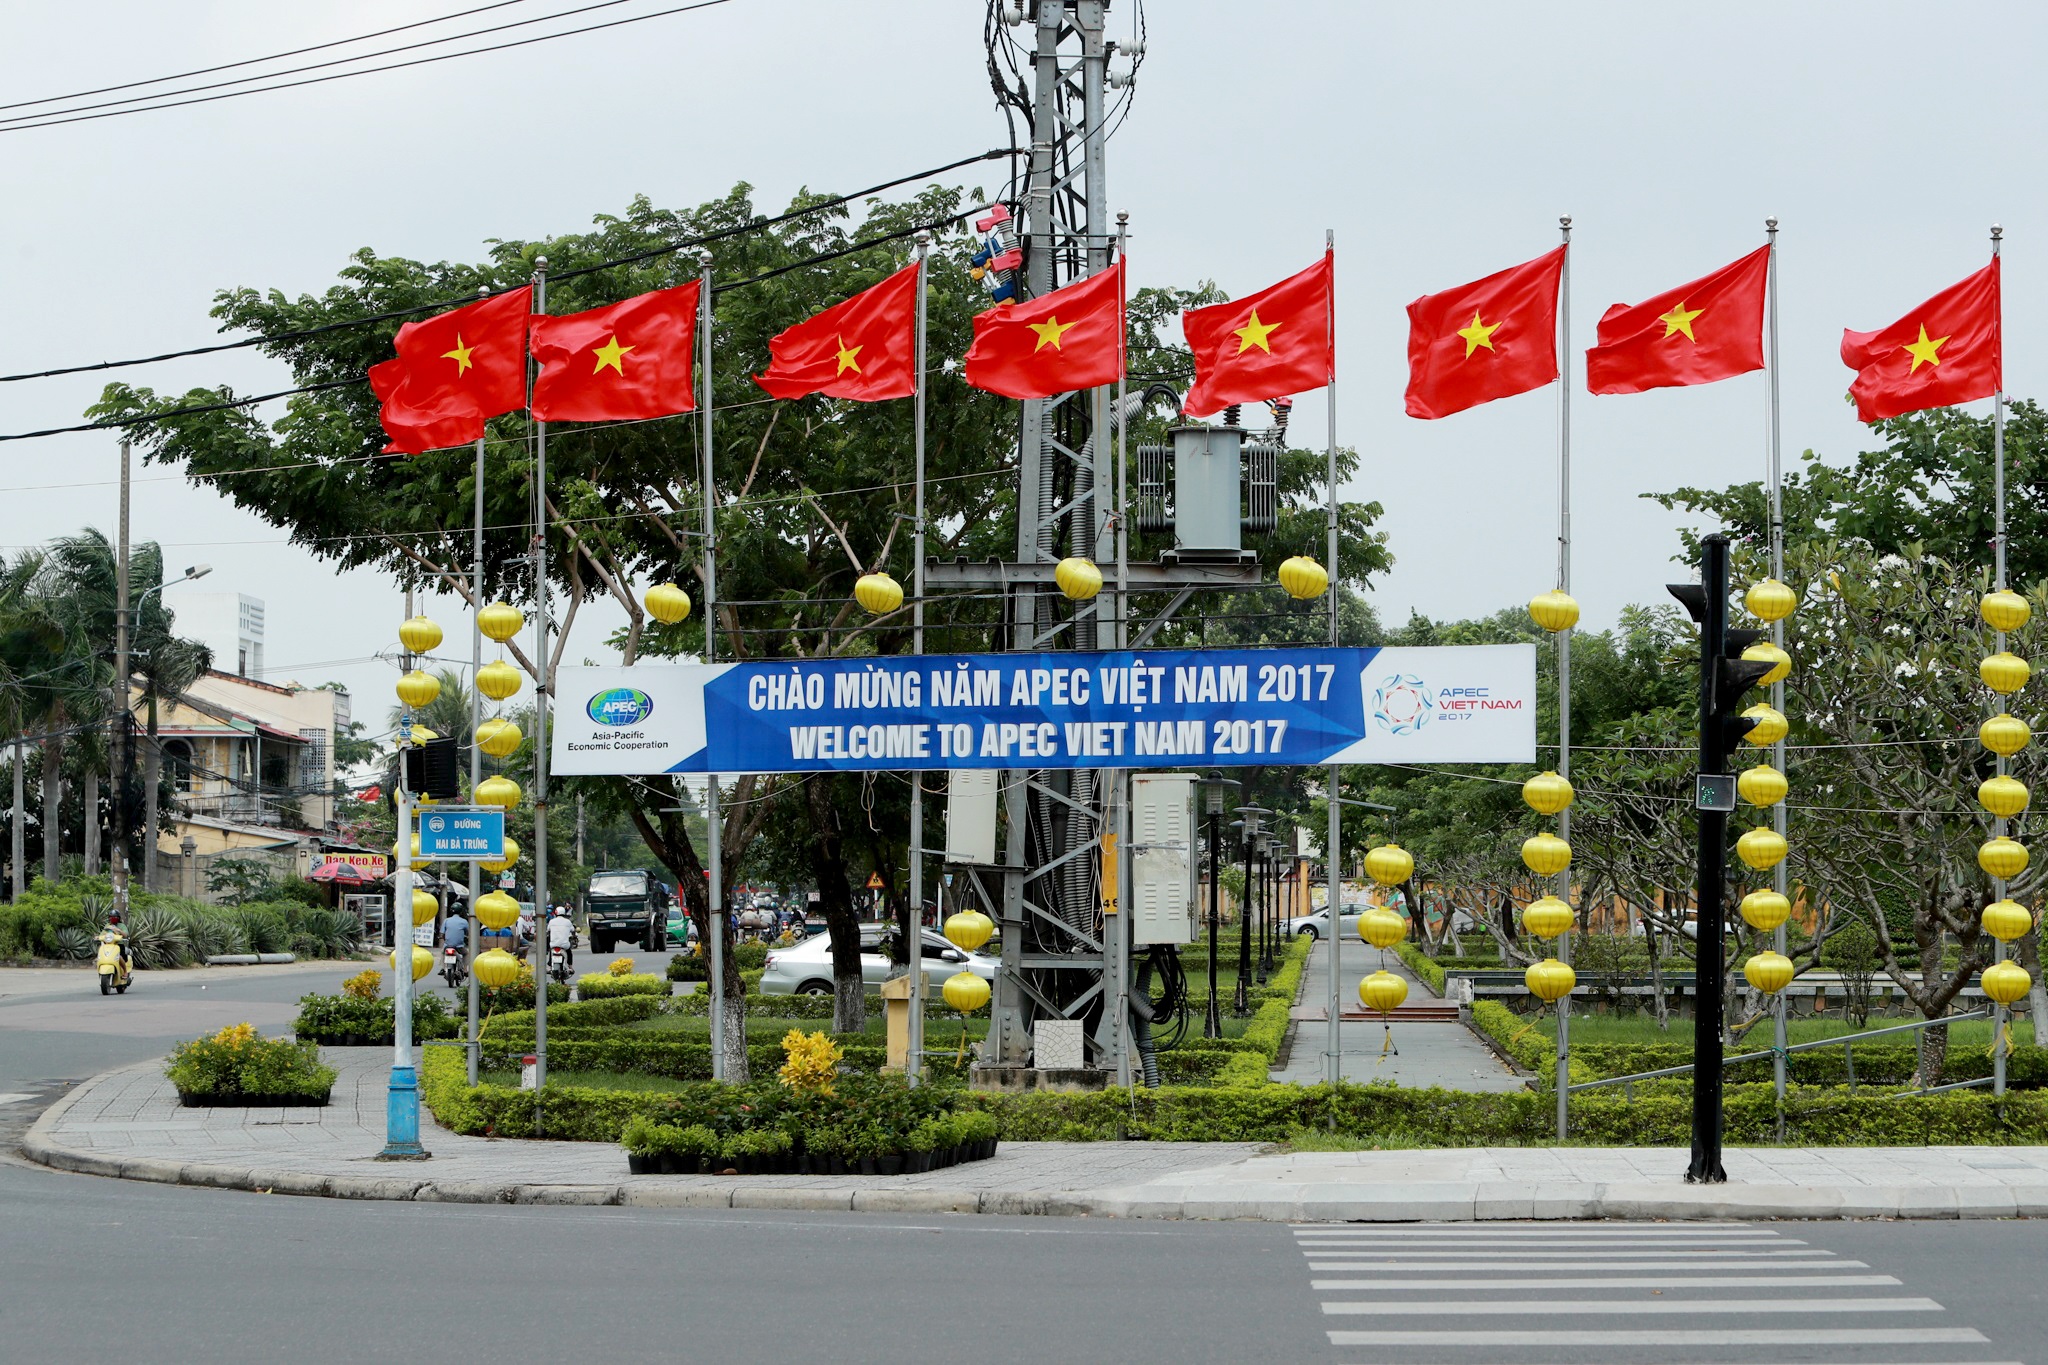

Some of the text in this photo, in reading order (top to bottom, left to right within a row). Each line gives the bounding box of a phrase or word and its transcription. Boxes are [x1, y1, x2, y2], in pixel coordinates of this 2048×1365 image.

[748, 659, 1335, 713] CHÀO MỪNG NĂM APEC VIỆT NAM 2017
[1439, 687, 1489, 698] APEC
[602, 700, 638, 713] APEC
[1439, 700, 1522, 710] VIET NAM
[1438, 713, 1473, 721] 2017
[592, 730, 645, 741] Asia-Pacific
[789, 719, 1288, 760] WELCOME TO APEC VIET NAM 2017
[567, 740, 669, 751] Economic Cooperation
[454, 818, 482, 829] ĐƯỜNG
[435, 836, 488, 850] HAI BÀ TRƯNG
[371, 855, 384, 866] Xe
